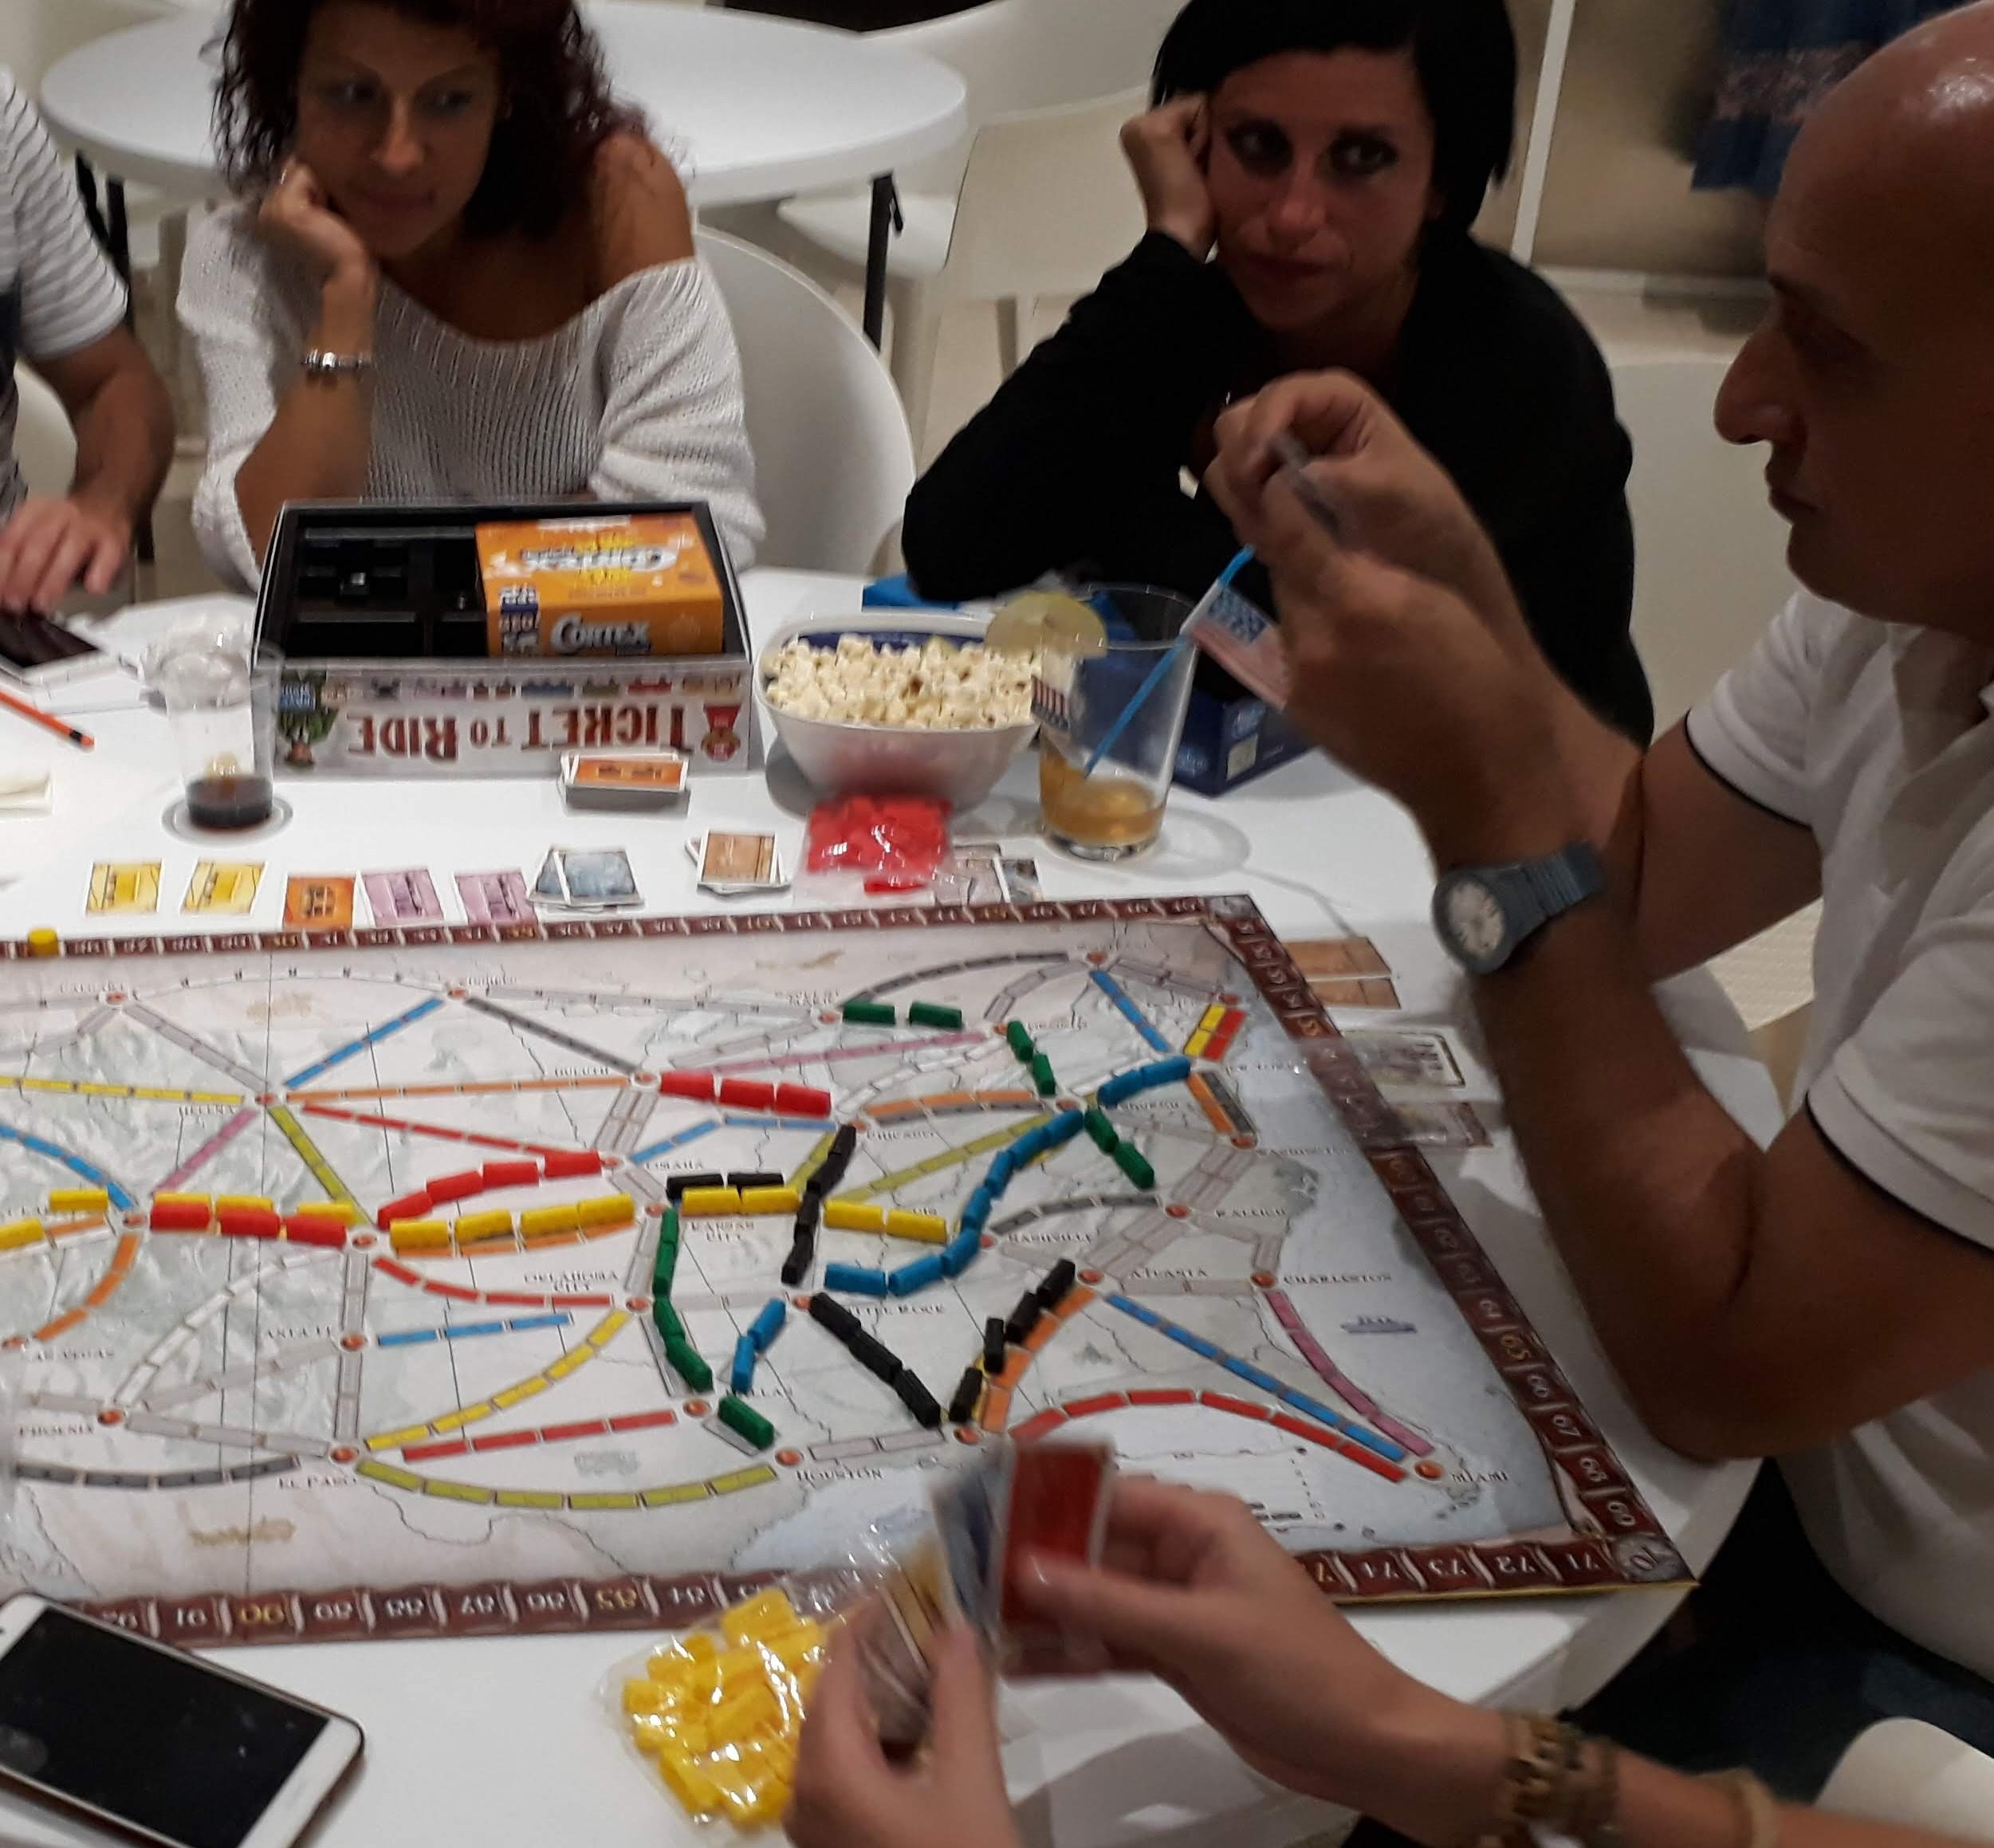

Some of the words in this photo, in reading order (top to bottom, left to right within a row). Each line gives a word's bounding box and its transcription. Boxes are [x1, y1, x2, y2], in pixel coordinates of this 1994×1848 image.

[347, 714, 458, 761] RIDE
[470, 718, 511, 749] TO
[521, 704, 693, 754] TICKET
[1500, 1334, 1531, 1361] 65
[1552, 1414, 1581, 1437] 67
[1452, 1470, 1508, 1482] MIAMI
[1579, 1457, 1607, 1482] 68
[1428, 1558, 1467, 1576] 73
[1499, 1557, 1535, 1576] 72
[461, 1595, 494, 1614] 87
[596, 1590, 637, 1609] 85
